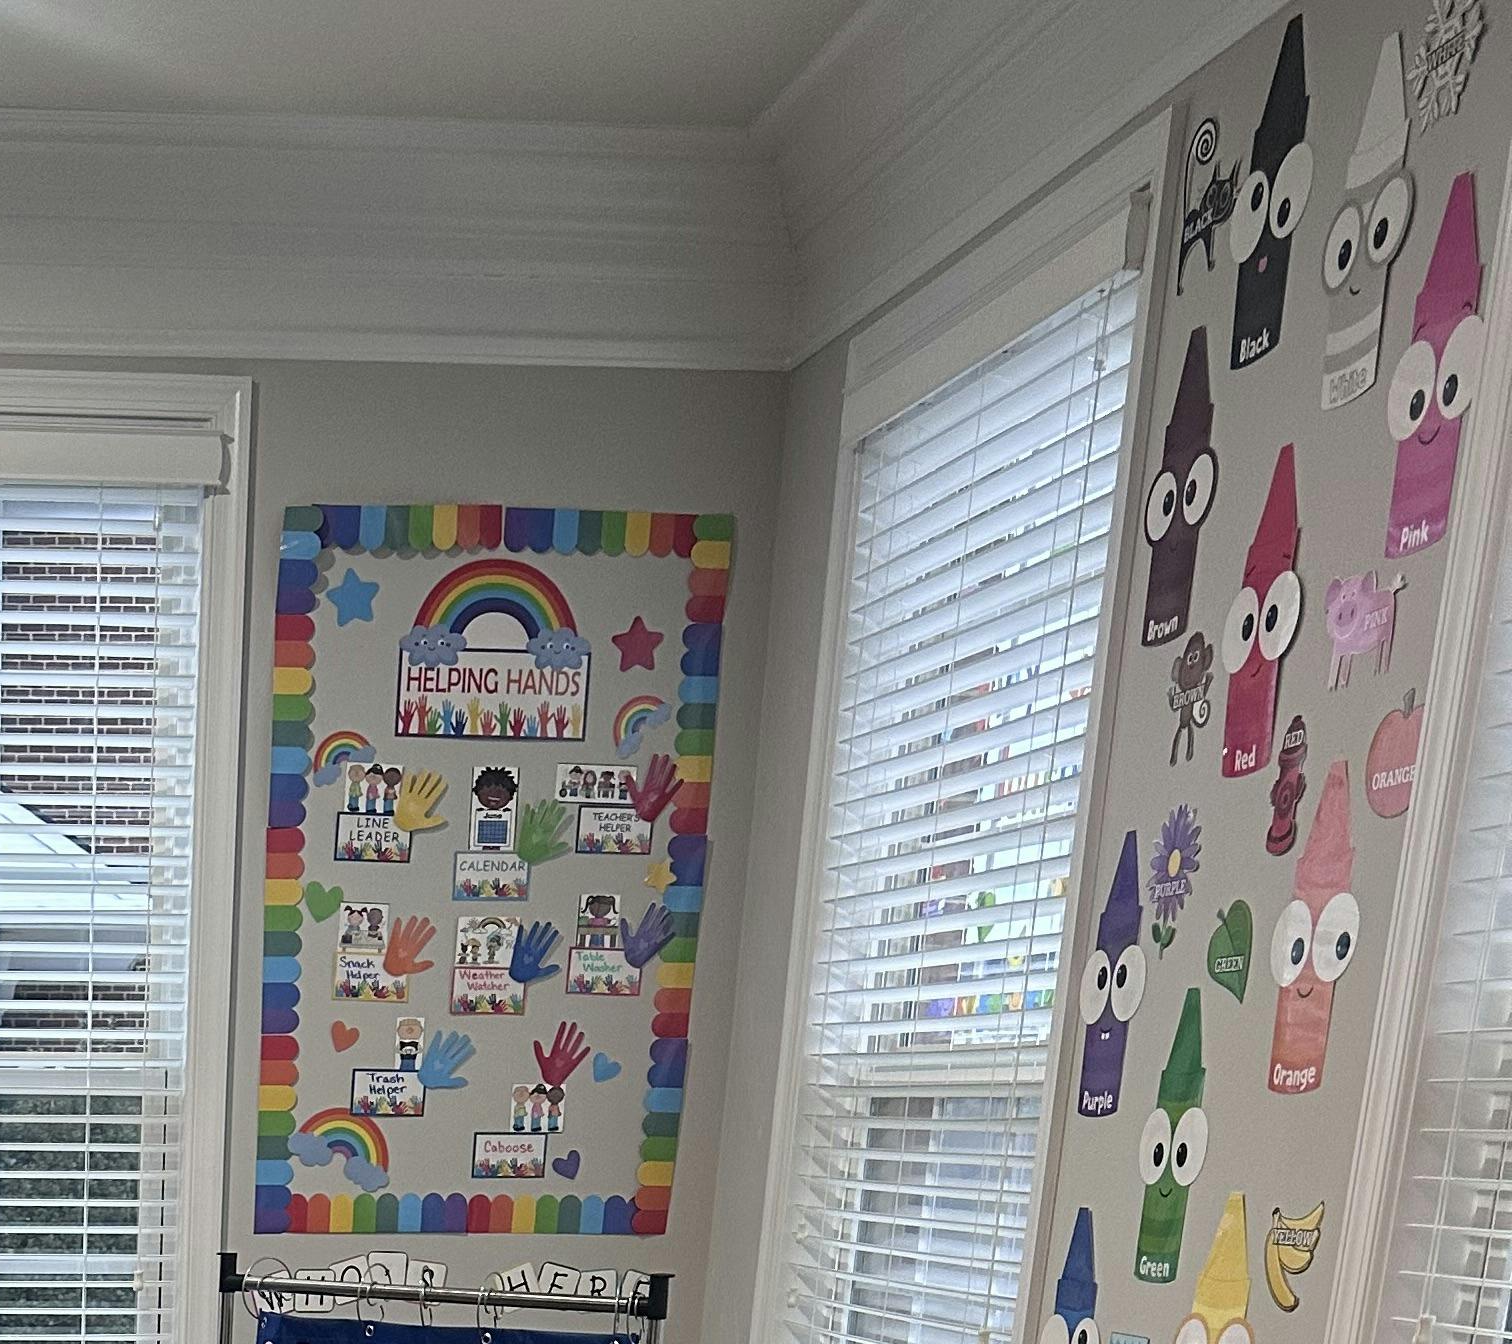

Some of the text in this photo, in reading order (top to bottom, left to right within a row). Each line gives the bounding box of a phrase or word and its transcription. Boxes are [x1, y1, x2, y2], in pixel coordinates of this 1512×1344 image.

[1184, 209, 1214, 243] BLACK
[1239, 329, 1270, 363] Black
[1329, 365, 1368, 402] White
[1400, 521, 1429, 550] Pink
[1147, 615, 1178, 641] Brown
[1364, 608, 1390, 631] PINK
[406, 666, 581, 696] HELPING HANDS
[1172, 686, 1205, 708] BROWN
[1284, 731, 1304, 749] RED
[1234, 745, 1256, 771] Red
[357, 817, 389, 829] LINE
[599, 823, 631, 832] HELPER
[349, 830, 399, 842] LEADER
[459, 860, 525, 872] CALENDAR
[1154, 879, 1186, 899] PURPLE
[339, 956, 376, 969] Snack
[576, 951, 605, 962] Table
[346, 970, 380, 981] Helper
[459, 970, 505, 980] Weather
[583, 963, 622, 973] Washer
[467, 981, 511, 992] Watcher
[366, 1072, 405, 1083] Trash
[1273, 1064, 1316, 1090] Orange
[369, 1084, 407, 1095] Helper
[1082, 1090, 1113, 1114] Purple
[483, 1140, 534, 1154] Caboose
[1273, 1227, 1315, 1247] YELLOW
[1140, 1256, 1170, 1278] Green
